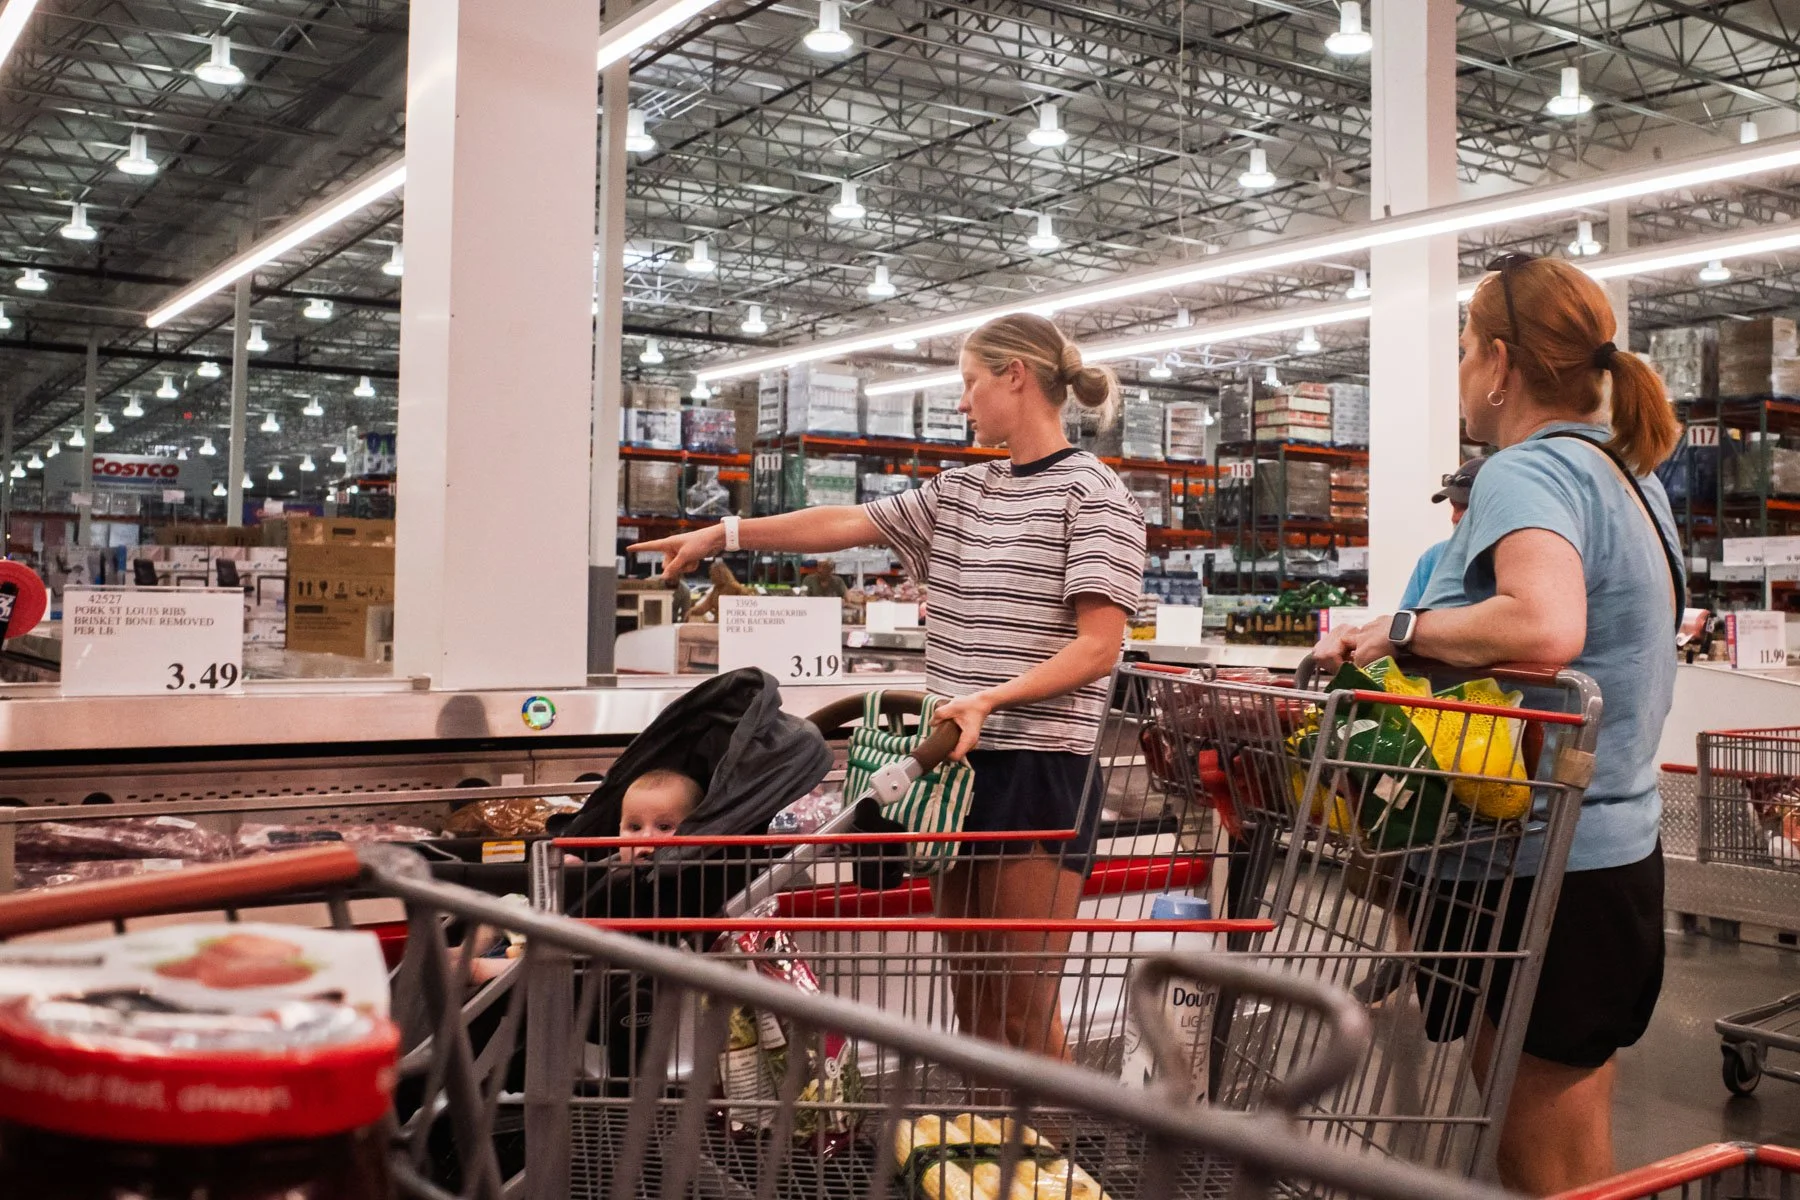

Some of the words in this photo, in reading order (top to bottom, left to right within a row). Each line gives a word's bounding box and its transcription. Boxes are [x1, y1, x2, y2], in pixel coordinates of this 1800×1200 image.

[1691, 427, 1716, 445] 117
[92, 457, 180, 478] COSTCO
[761, 455, 778, 469] 111
[1233, 463, 1252, 477] 113
[88, 594, 122, 604] 42527
[75, 606, 105, 615] PORK
[109, 607, 122, 615] ST
[125, 606, 160, 615] LOUIS
[162, 607, 187, 616] RIBS
[726, 609, 747, 617] PORK
[749, 609, 768, 617] LOIN
[74, 616, 122, 626] BRISKET
[125, 616, 157, 626] BONE
[159, 617, 215, 627] REMOVED
[73, 626, 95, 635] PER
[1760, 649, 1785, 664] 11.99
[790, 654, 839, 678] 3.19
[165, 662, 239, 690] 3.49
